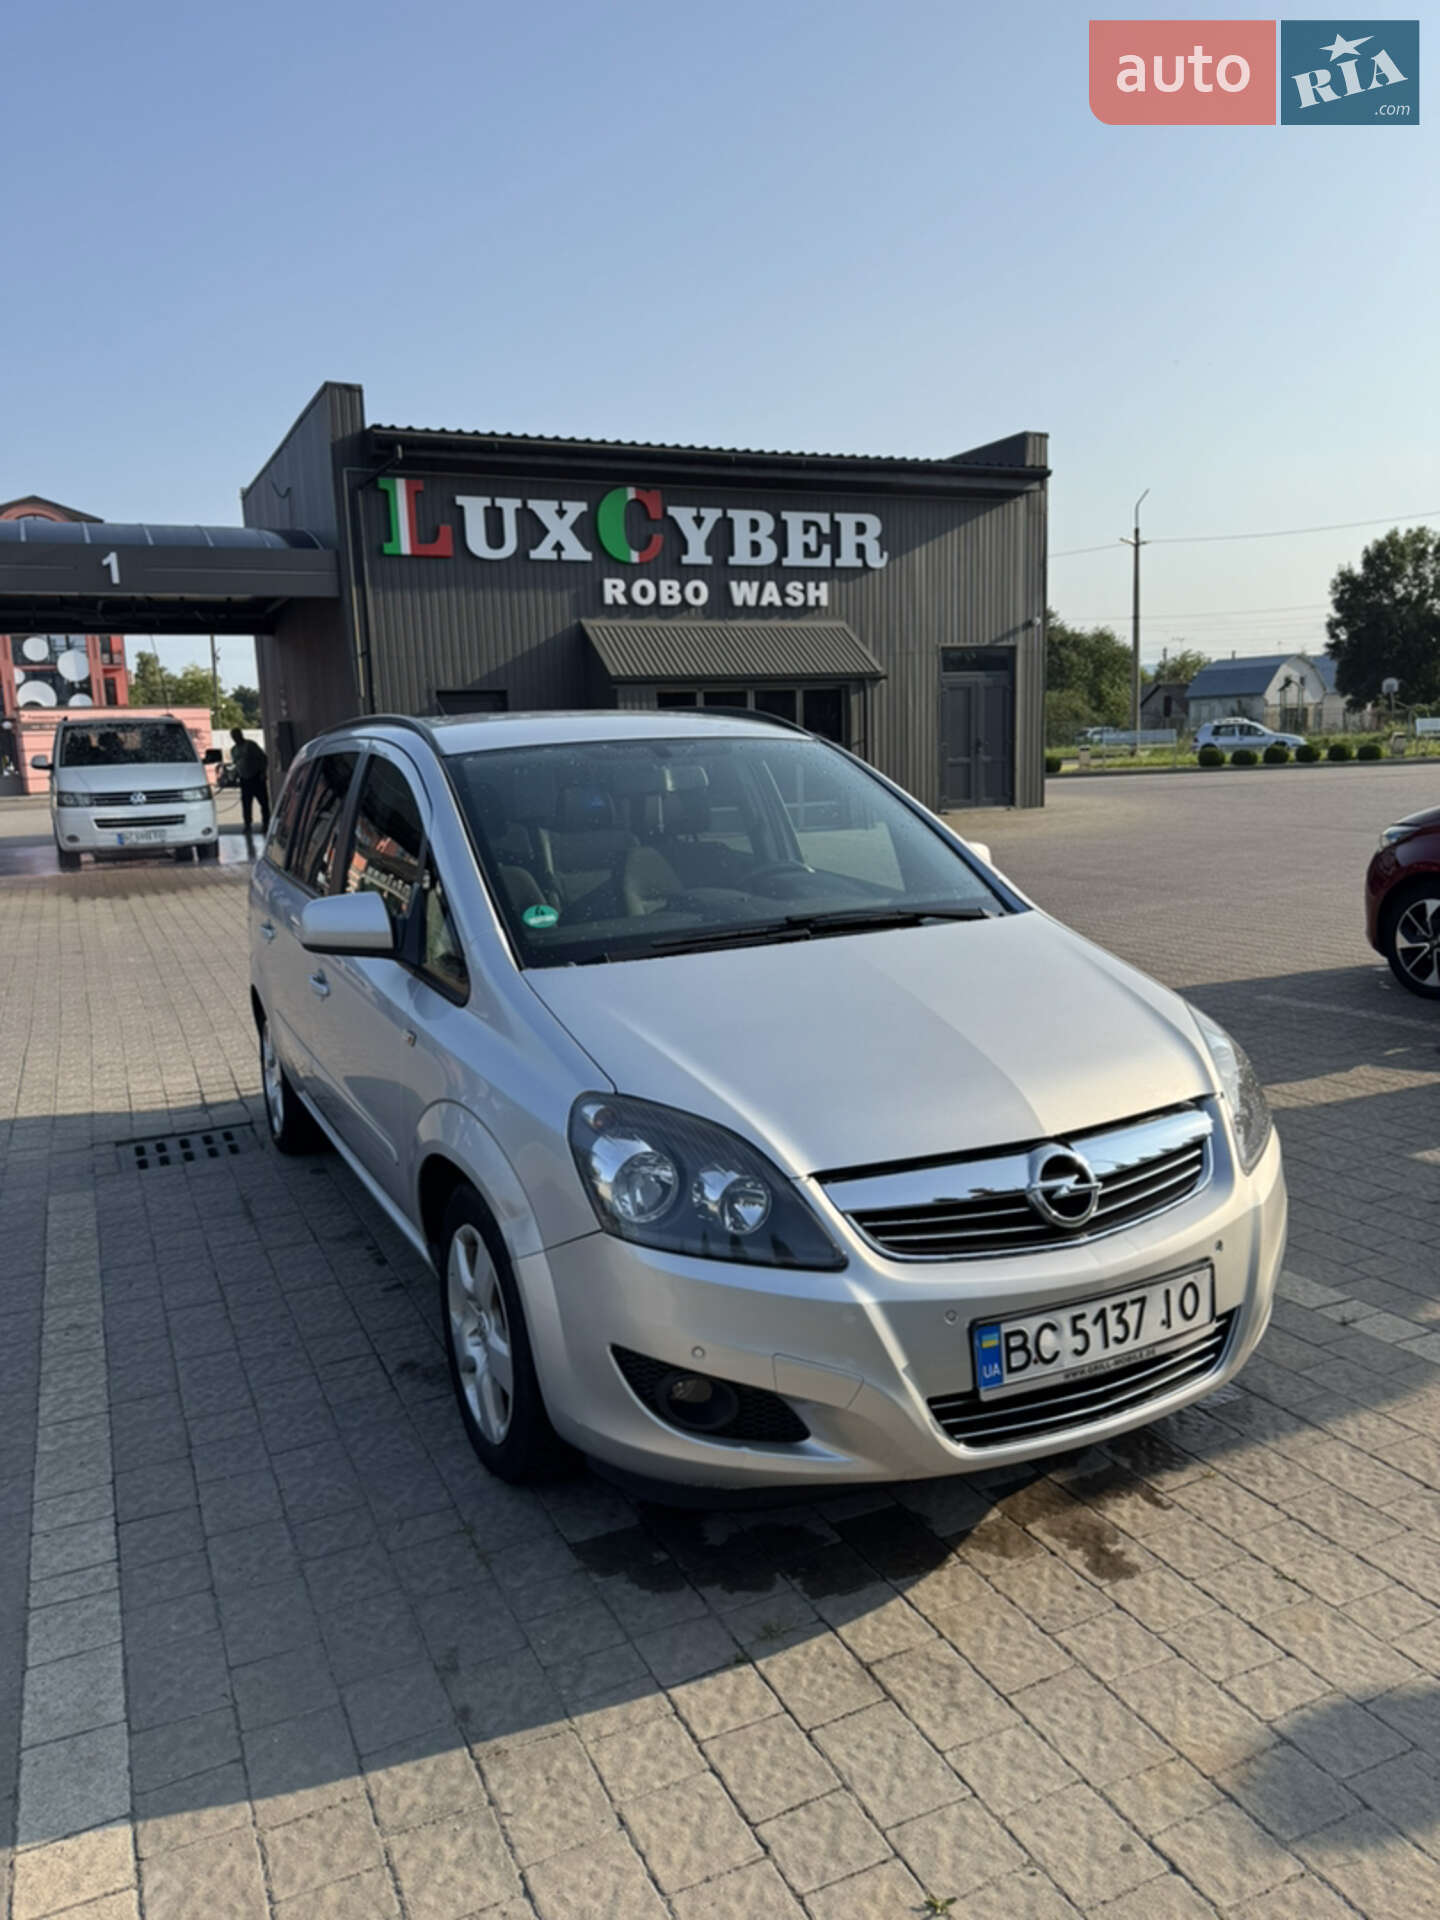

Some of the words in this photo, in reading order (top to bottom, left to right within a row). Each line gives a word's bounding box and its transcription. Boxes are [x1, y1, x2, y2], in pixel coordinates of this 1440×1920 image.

[102, 551, 121, 584] 1
[603, 578, 709, 607] ROBO
[730, 580, 829, 607] WASH
[1004, 1322, 1060, 1374] BC
[1071, 1295, 1147, 1357] 5137
[983, 1364, 1001, 1378] UA
